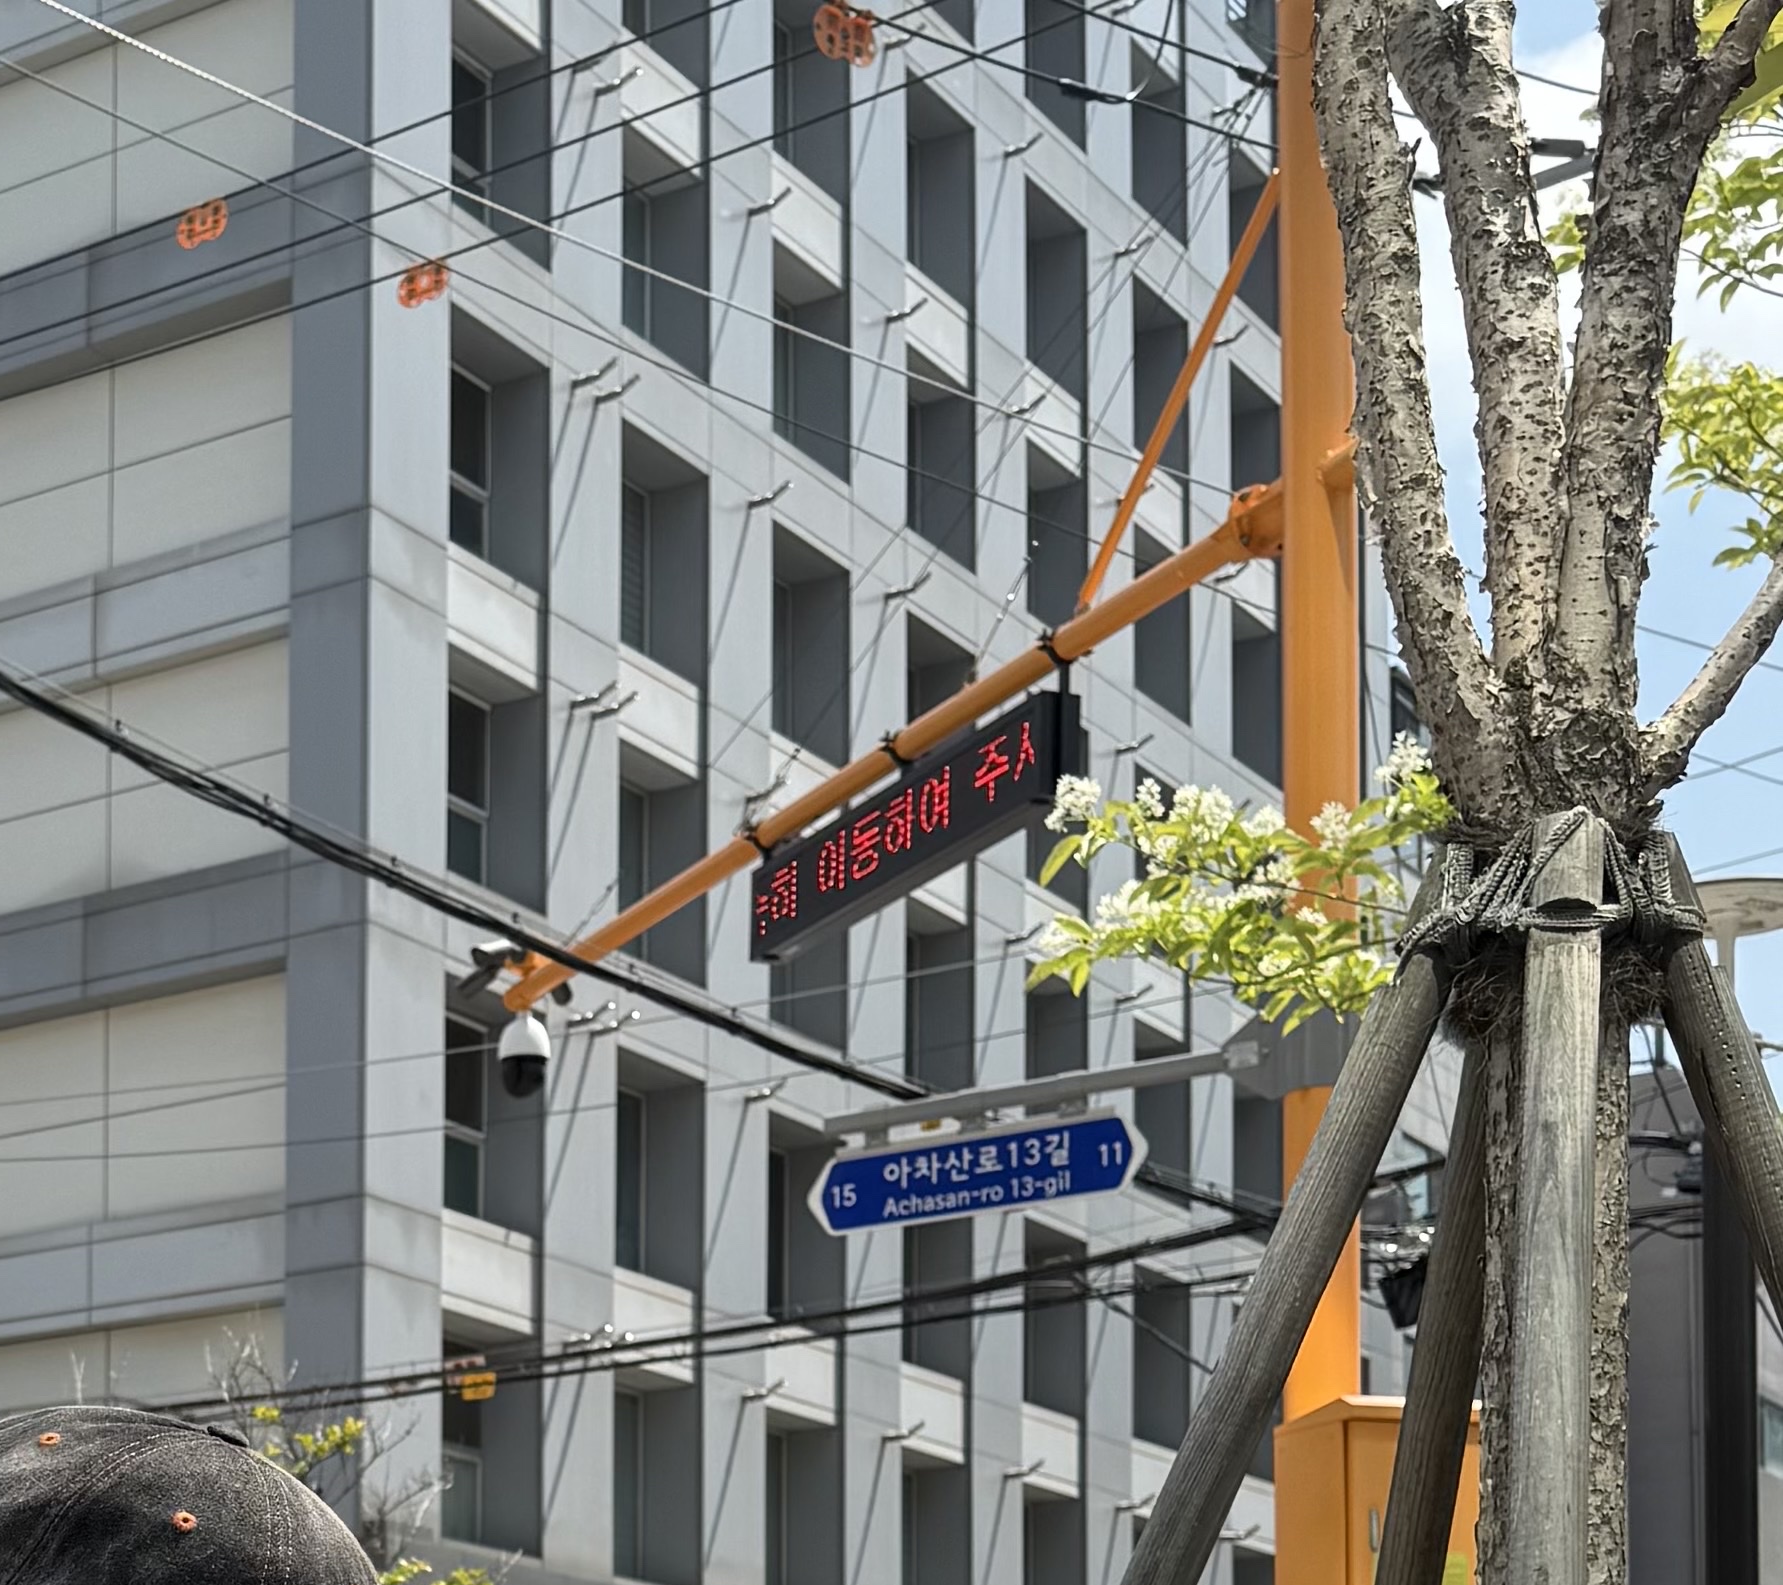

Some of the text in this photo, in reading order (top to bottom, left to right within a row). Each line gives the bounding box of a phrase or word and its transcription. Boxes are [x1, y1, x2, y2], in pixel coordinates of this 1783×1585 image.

[817, 766, 951, 893] 이동하여
[882, 1131, 1071, 1190] 아차산로13길
[1098, 1141, 1123, 1167] 11
[830, 1184, 857, 1209] 15
[882, 1171, 1072, 1218] Achasan-ro 13-gil
